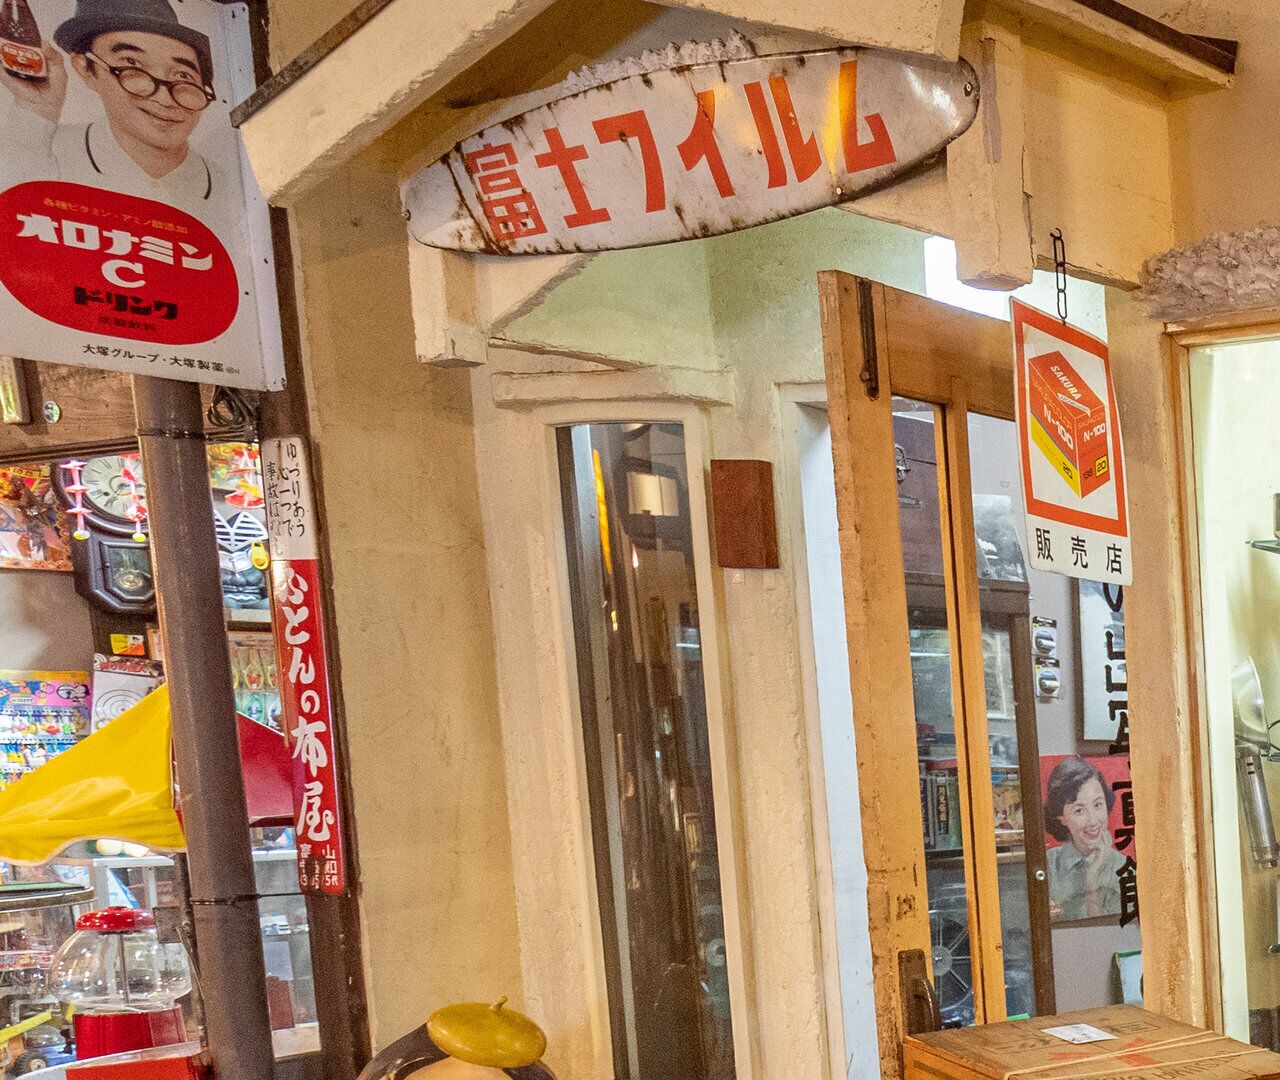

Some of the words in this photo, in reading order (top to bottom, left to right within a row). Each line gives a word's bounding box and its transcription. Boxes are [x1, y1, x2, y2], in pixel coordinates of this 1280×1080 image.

[465, 60, 897, 241] 富士フイルム
[16, 213, 213, 271] オロナミン
[101, 260, 146, 288] C
[75, 286, 178, 320] ドリンク
[1050, 365, 1082, 400] SAKURA
[1043, 404, 1075, 450] N-100
[1083, 423, 1106, 442] N-100
[1096, 460, 1107, 473] 20
[1035, 527, 1123, 575] 販売店
[283, 565, 335, 841] ふとんの布屋
